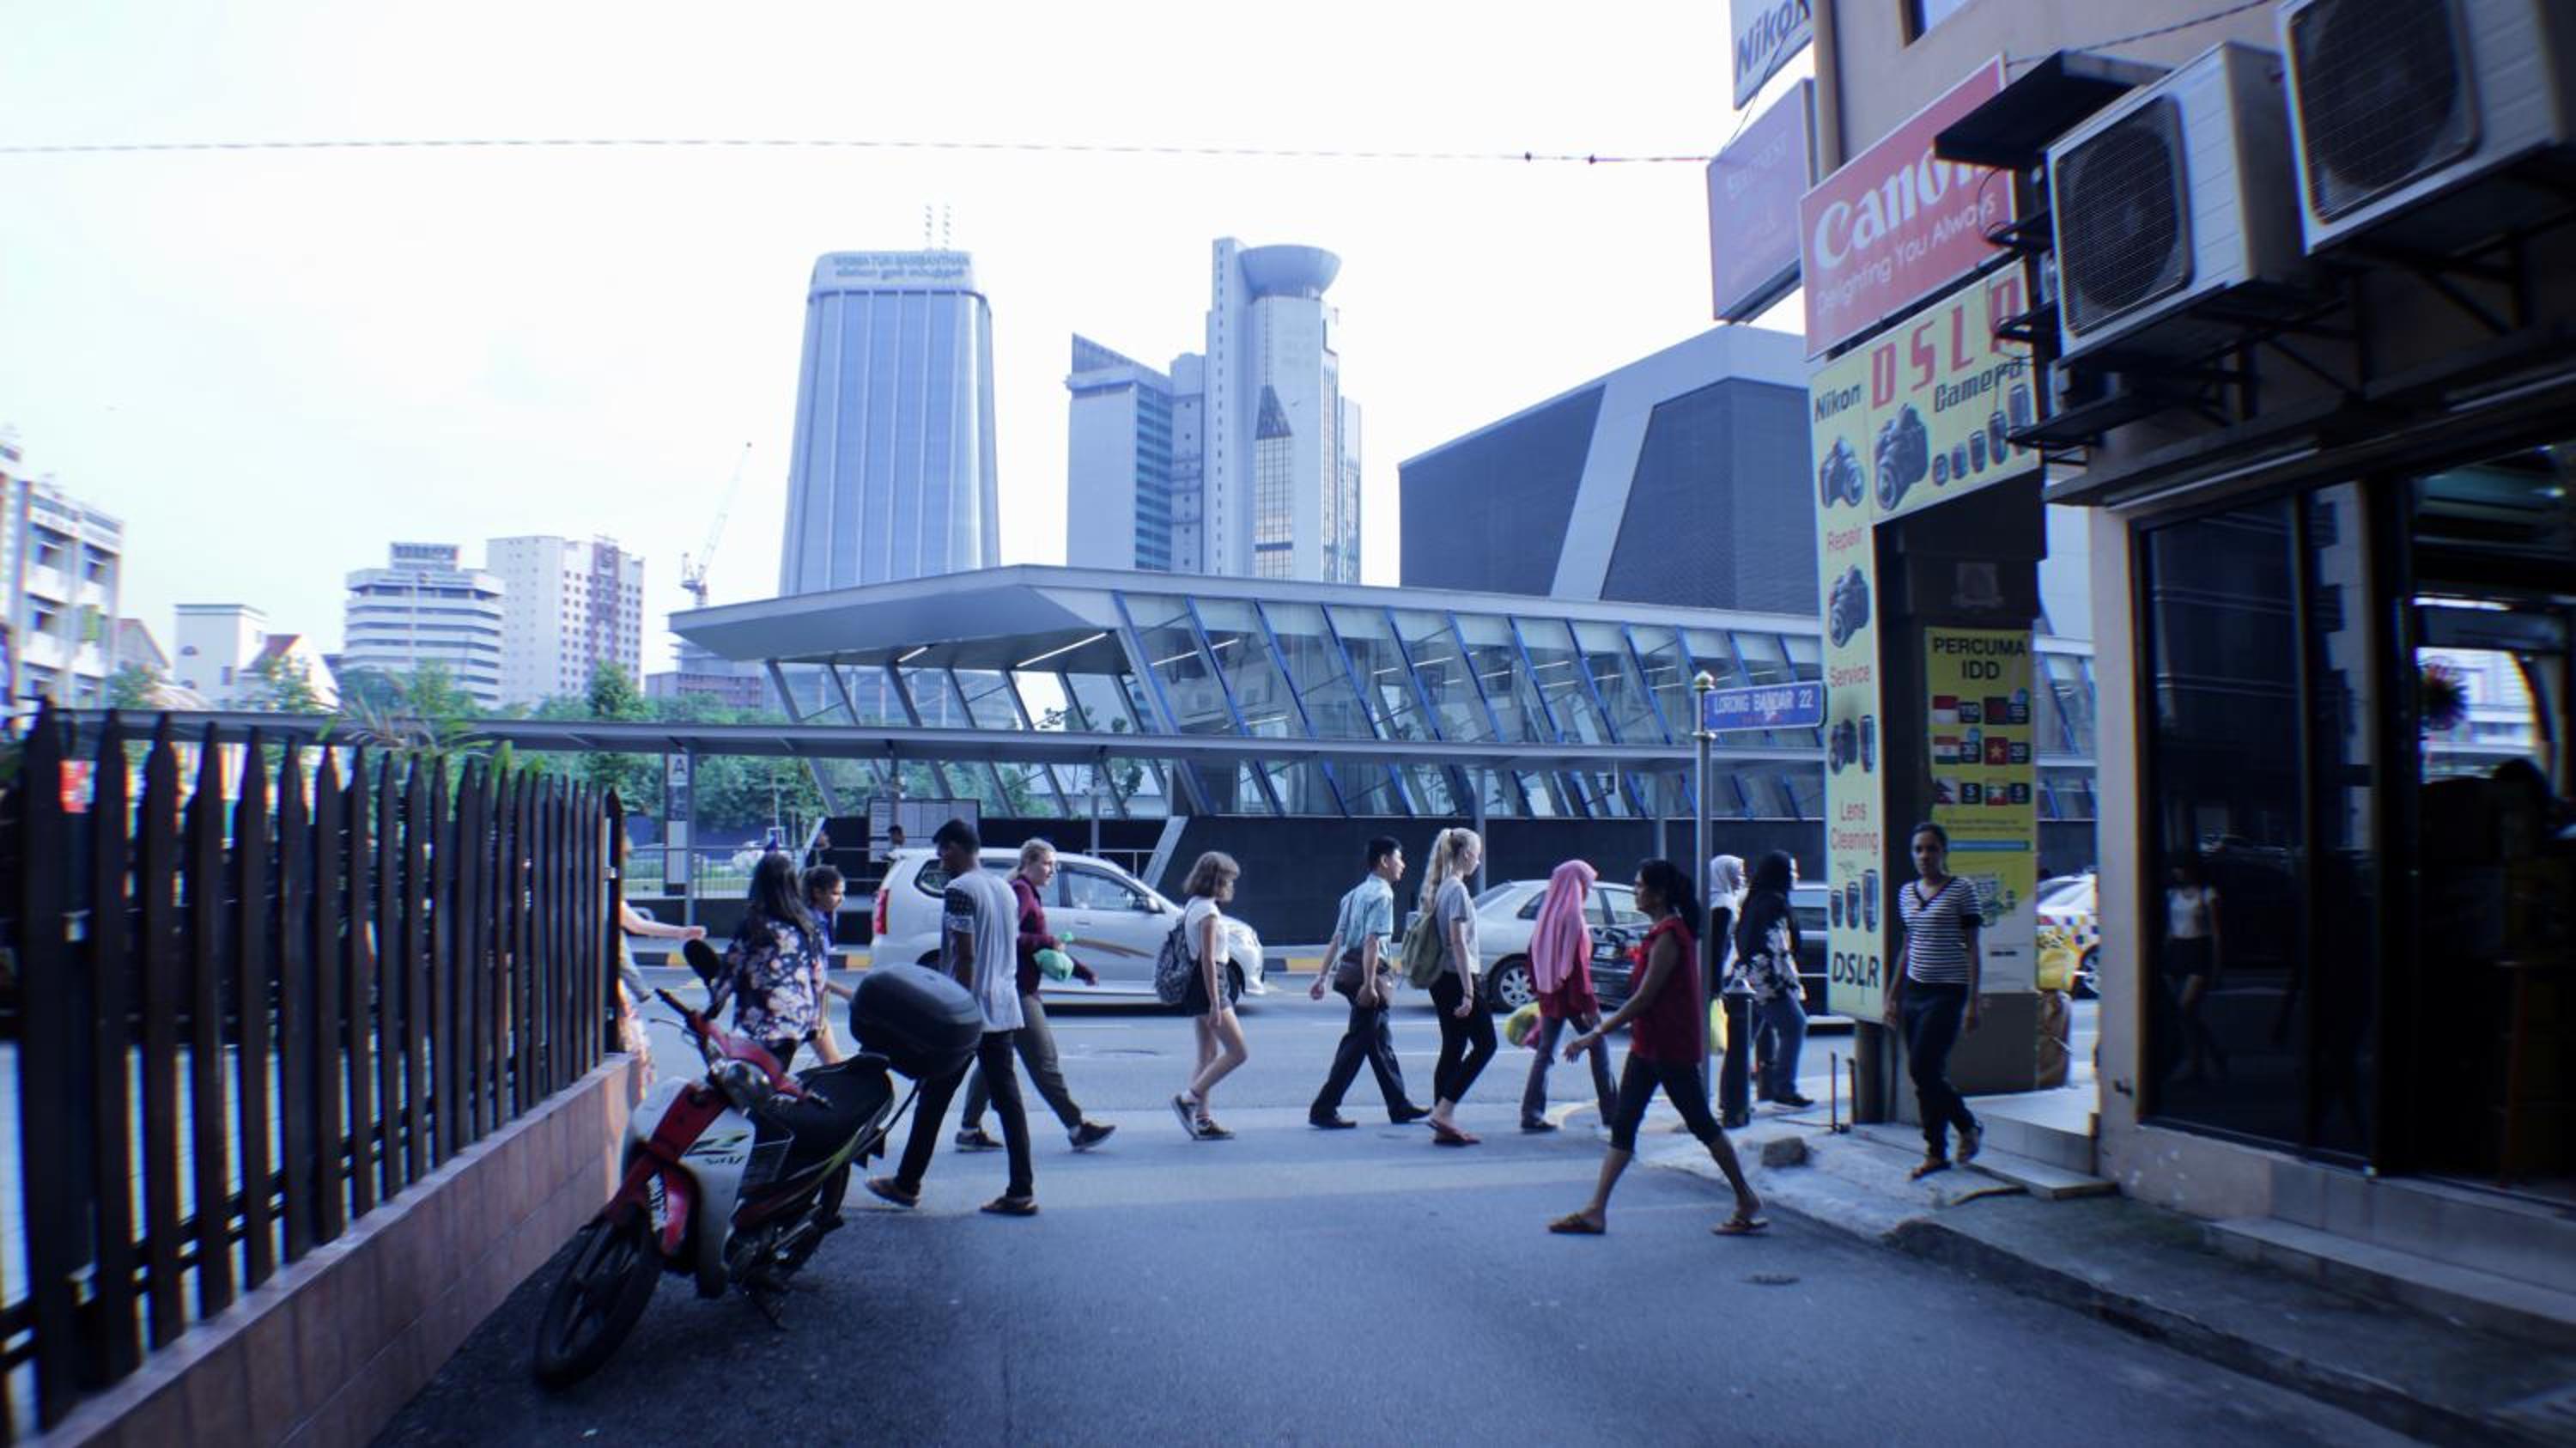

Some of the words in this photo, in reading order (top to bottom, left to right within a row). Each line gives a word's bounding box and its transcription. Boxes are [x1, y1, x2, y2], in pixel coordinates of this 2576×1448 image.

[1814, 149, 1988, 271] Cano
[1894, 236, 1928, 272] You
[1934, 359, 2024, 413] Camera
[1814, 384, 1862, 423] Nikon
[1826, 526, 1863, 552] Repair
[1933, 636, 2027, 657] PERCUMA
[1829, 663, 1870, 688] Service
[1961, 660, 2001, 680] IDD
[1799, 689, 1814, 709] 22
[1840, 800, 1867, 822] Lens
[1831, 828, 1879, 856] Cleaning
[1832, 951, 1880, 989] DSLR
